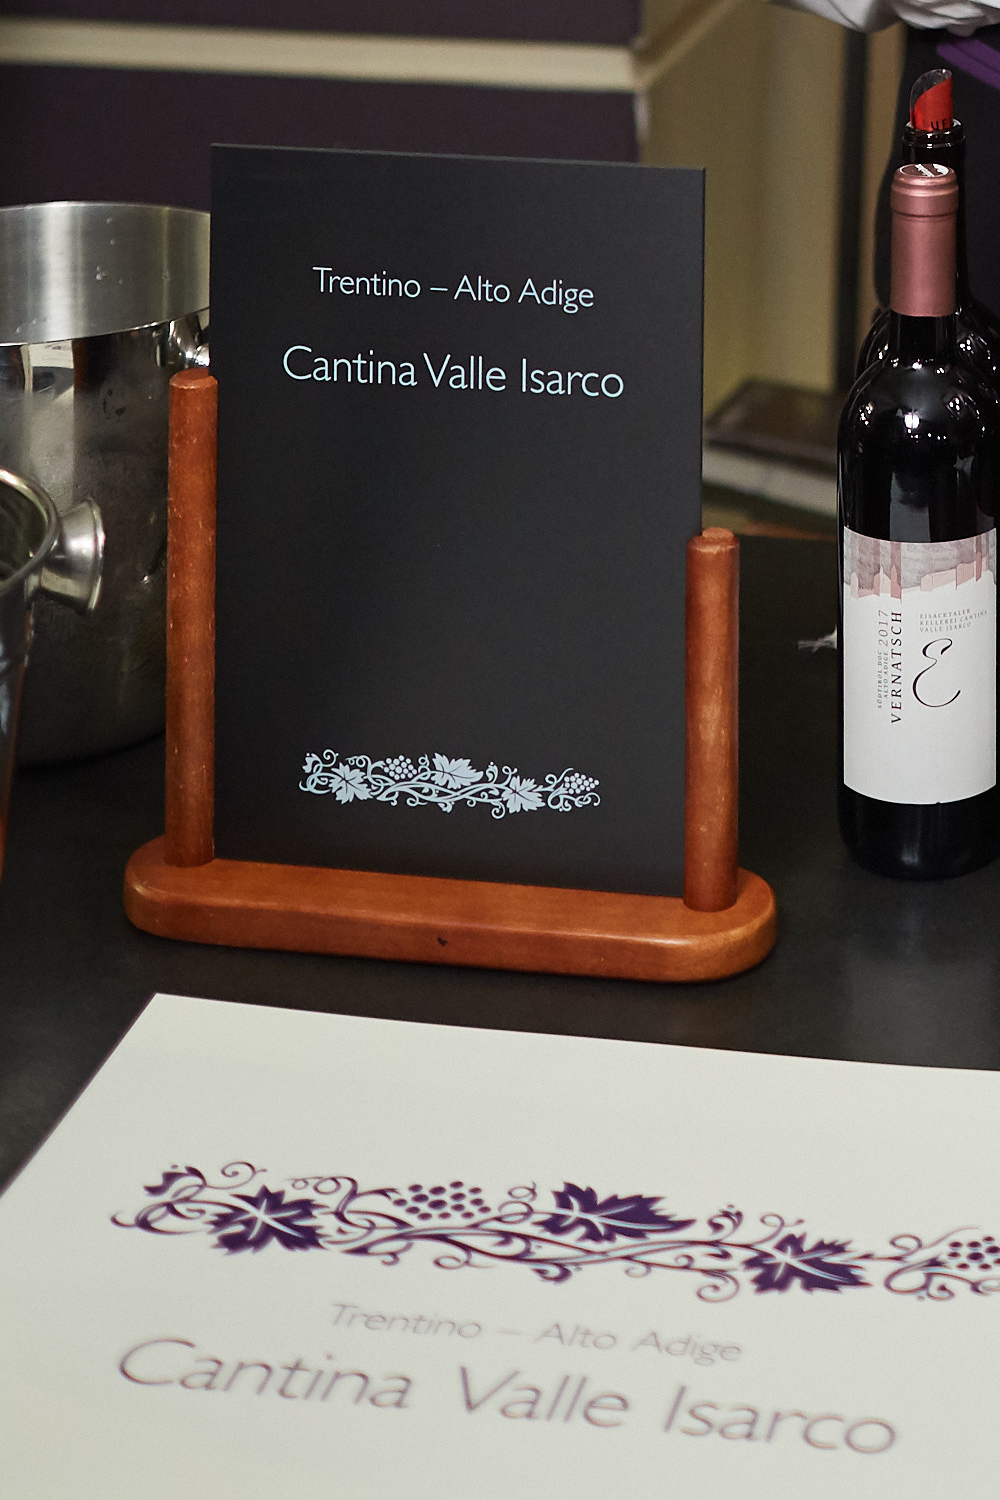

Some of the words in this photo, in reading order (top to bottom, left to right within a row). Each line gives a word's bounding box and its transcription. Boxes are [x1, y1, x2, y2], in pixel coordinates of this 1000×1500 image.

[312, 266, 421, 298] Trentino
[454, 274, 510, 303] Alto
[518, 278, 594, 314] Adige
[283, 345, 418, 387] Cantina
[423, 352, 507, 391] Valle
[521, 358, 624, 398] Isarco
[878, 610, 888, 647] 2017
[891, 611, 901, 724] VERNATSCH
[330, 1302, 483, 1340] Trentino
[534, 1321, 617, 1350] Alto
[631, 1331, 744, 1367] Adige
[117, 1336, 413, 1410] Cantina
[458, 1364, 629, 1429] Valle
[664, 1384, 898, 1455] Isarco
